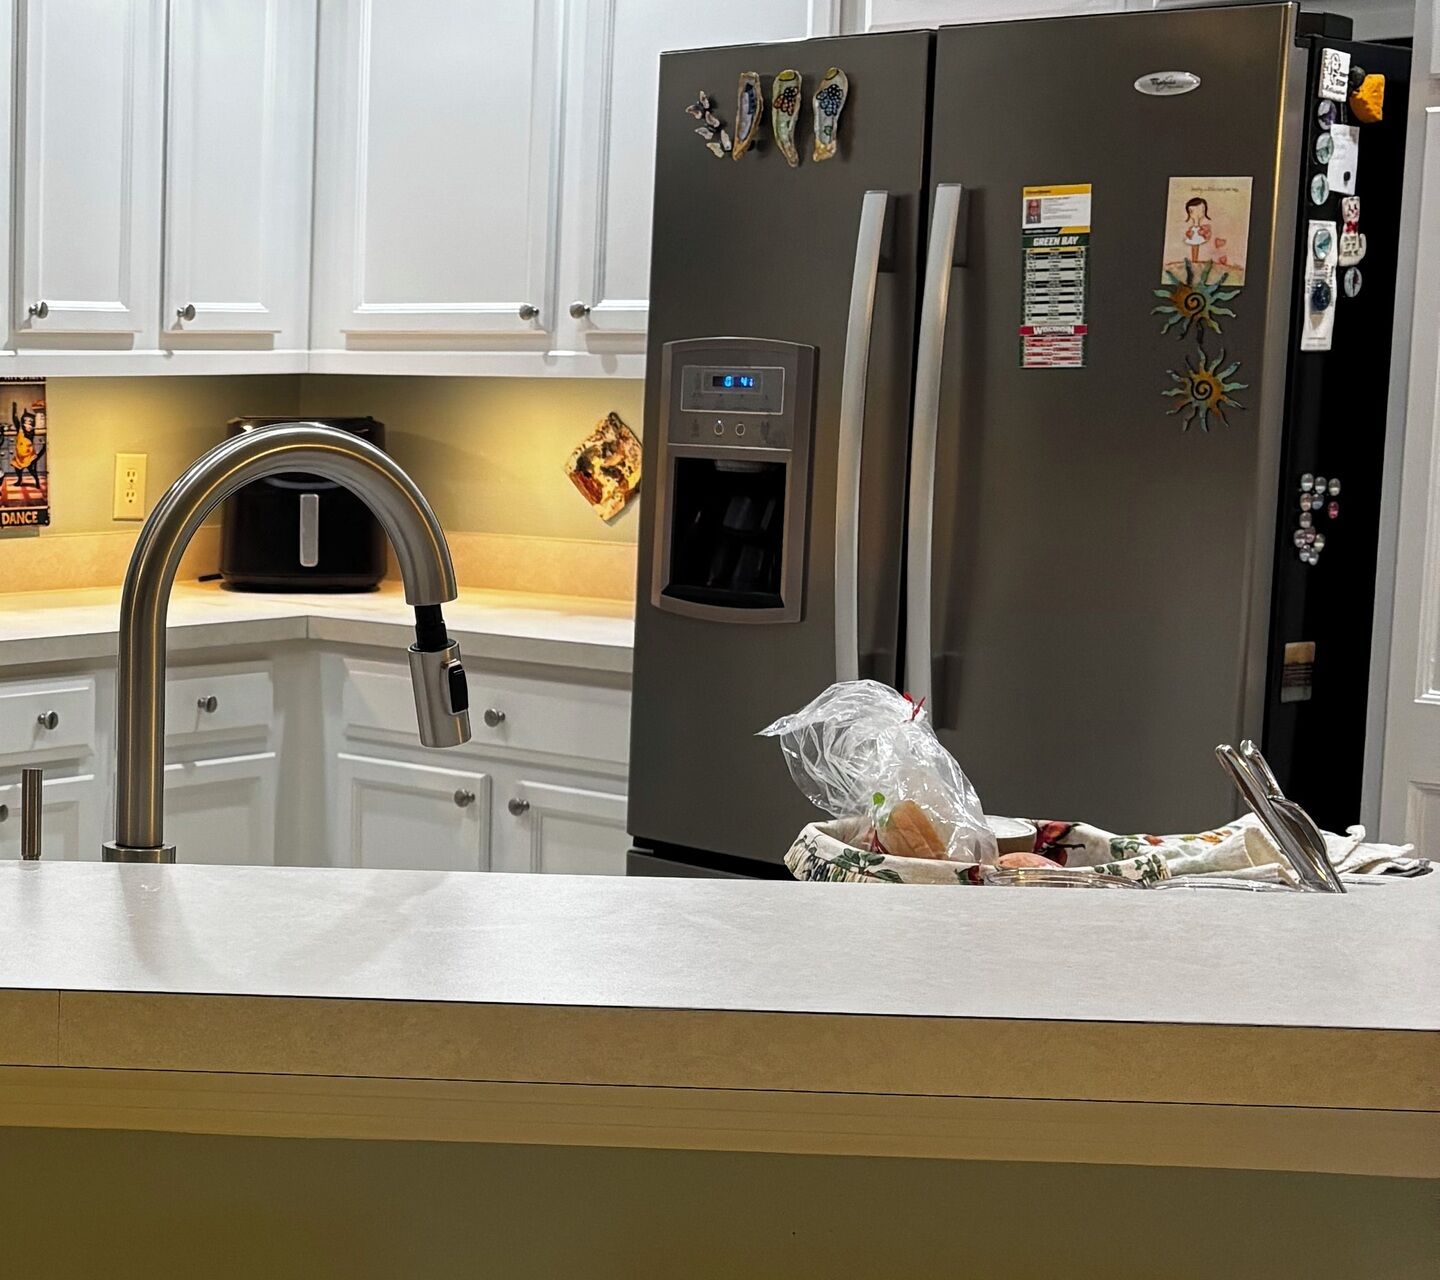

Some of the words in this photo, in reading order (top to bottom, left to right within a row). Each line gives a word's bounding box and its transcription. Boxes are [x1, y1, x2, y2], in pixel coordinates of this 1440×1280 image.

[1033, 237, 1060, 247] GREEN
[1061, 236, 1080, 246] BAY
[1, 511, 39, 525] DANCE
